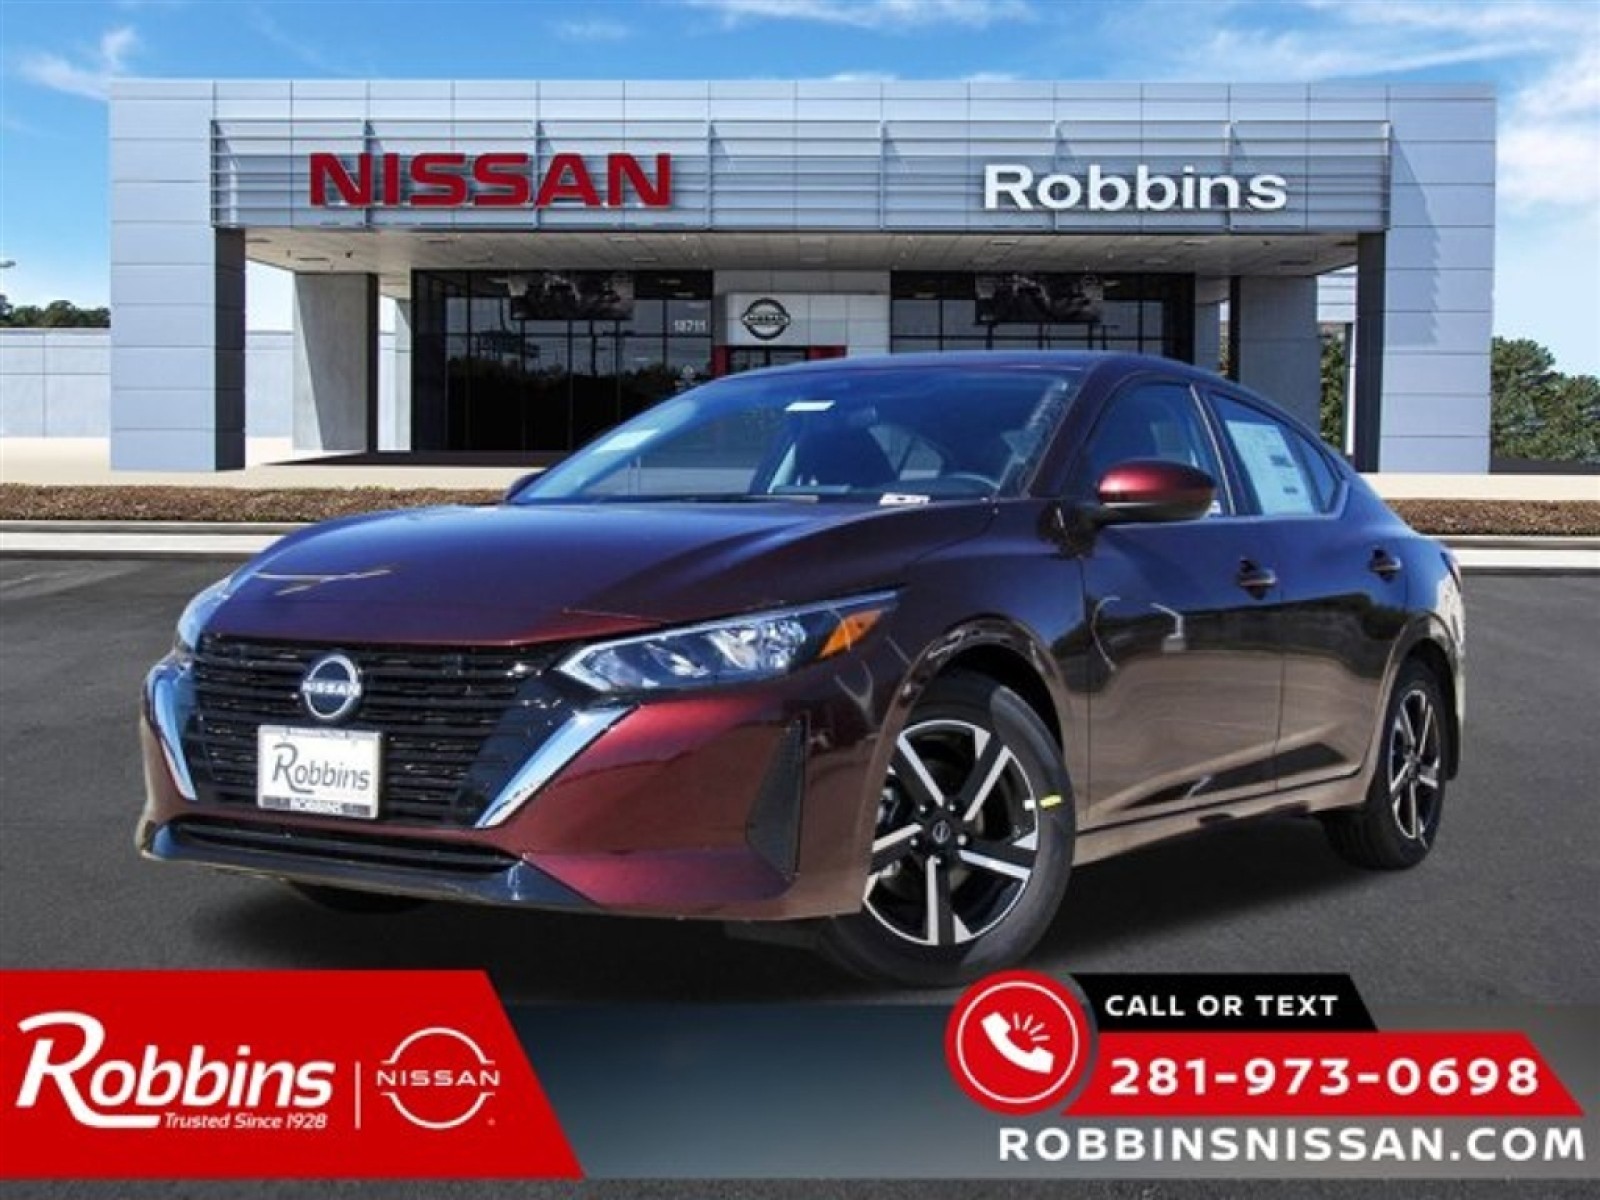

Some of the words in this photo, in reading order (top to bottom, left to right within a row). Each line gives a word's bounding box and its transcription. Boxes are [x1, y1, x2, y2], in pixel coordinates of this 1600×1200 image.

[309, 153, 672, 207] NISSAN
[984, 164, 1287, 210] Robbins
[272, 742, 371, 795] Robbins
